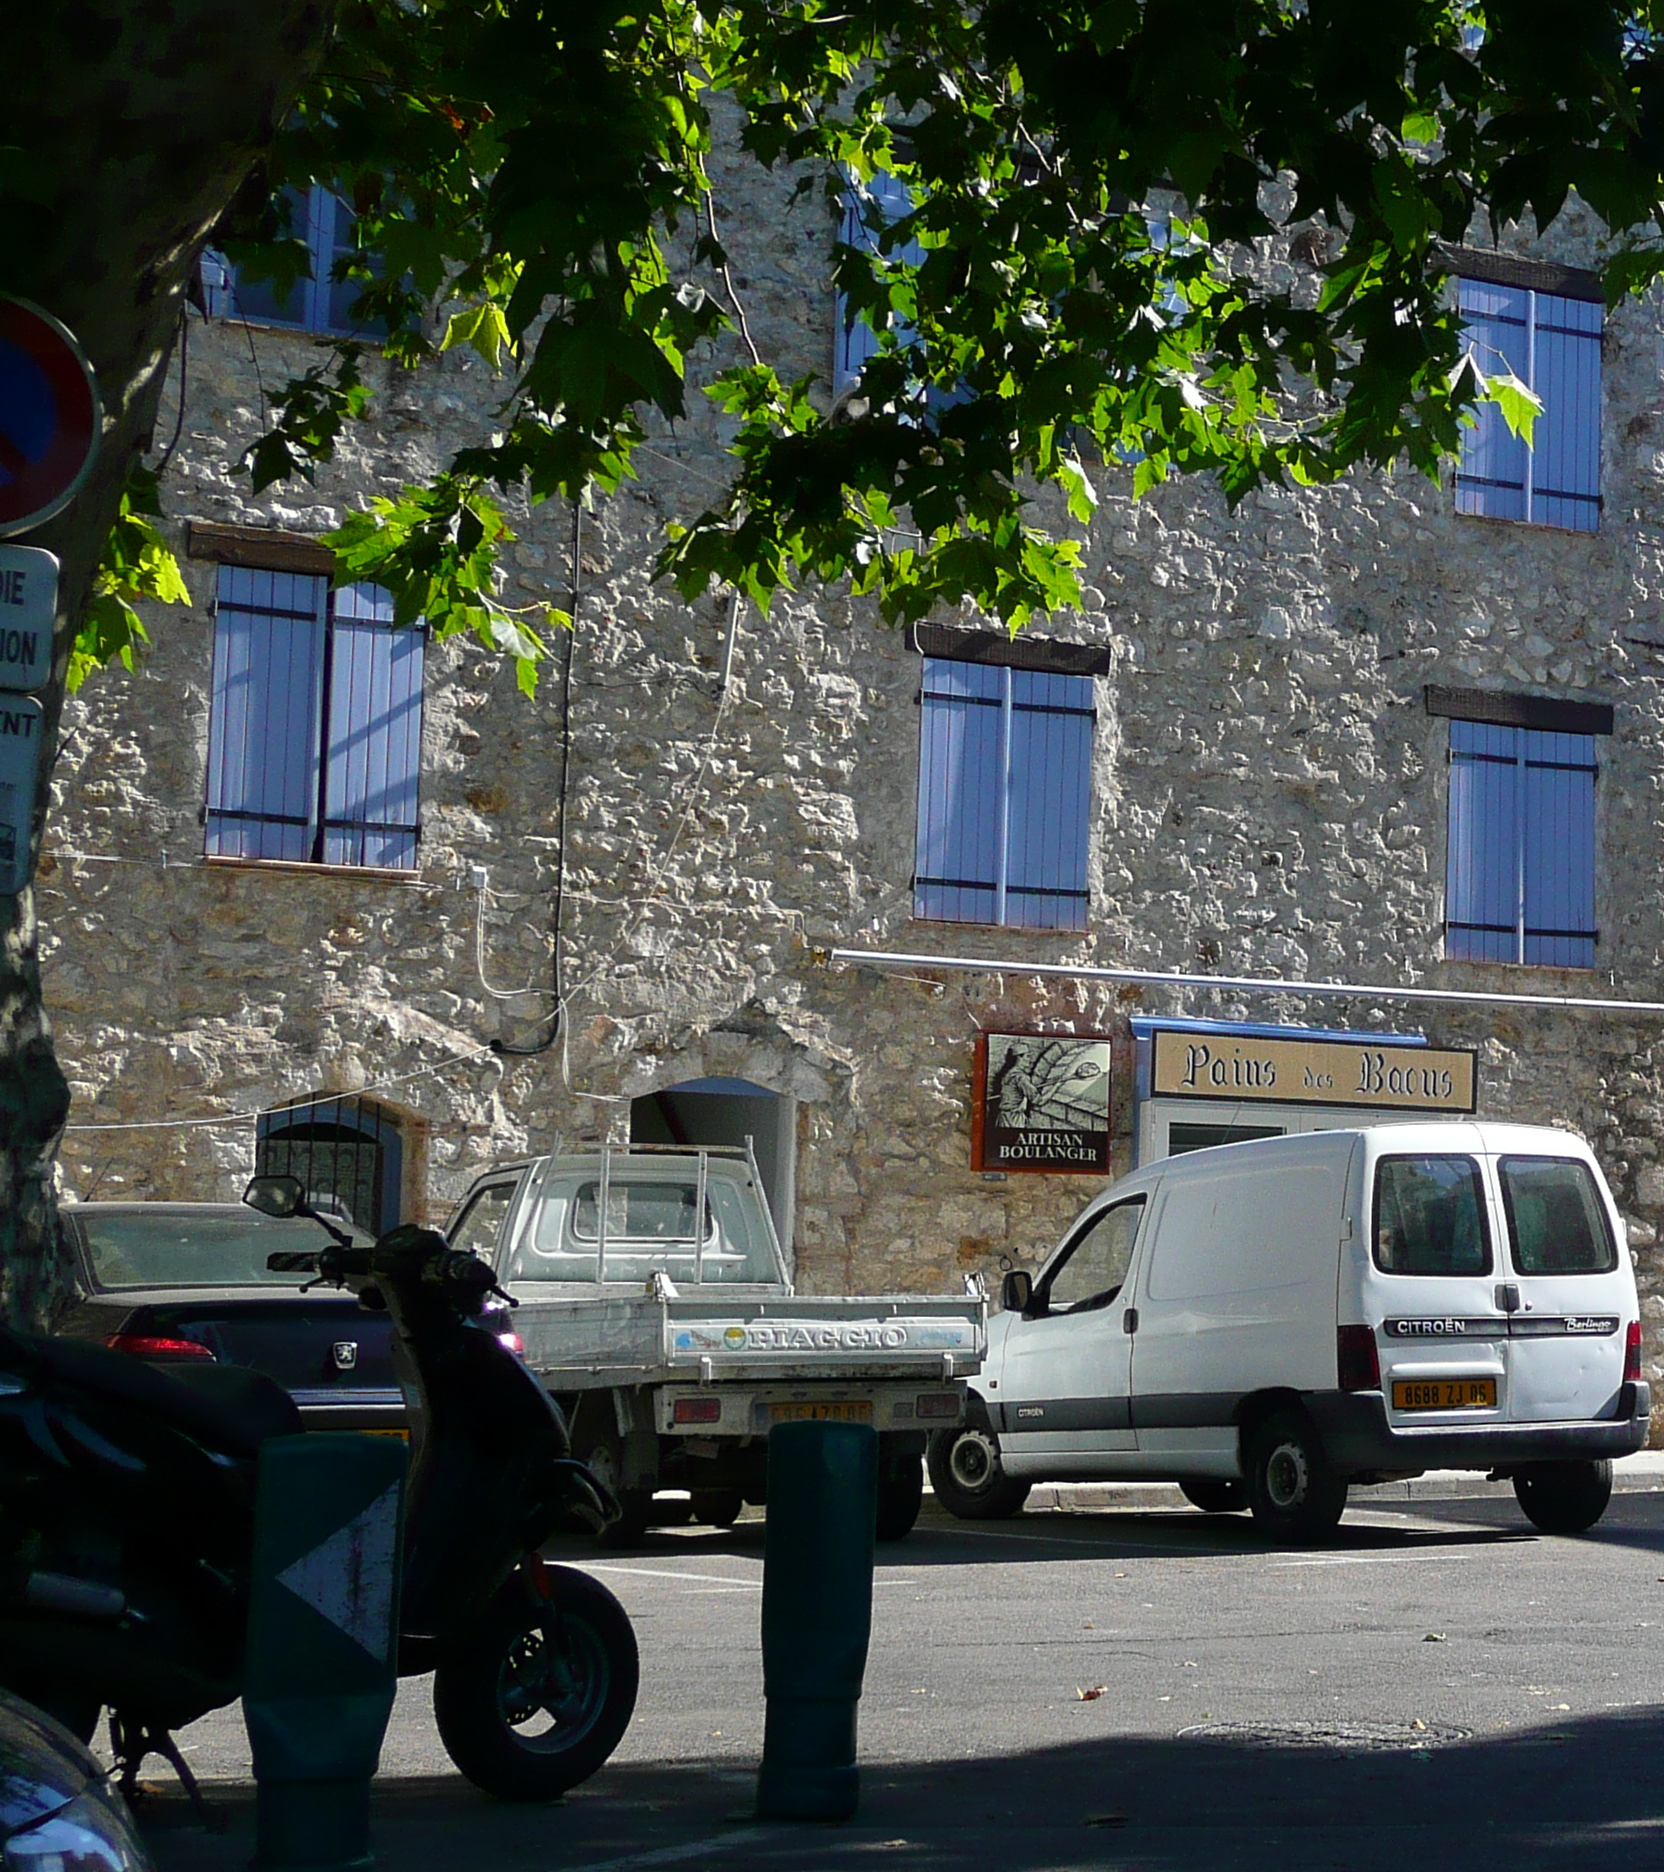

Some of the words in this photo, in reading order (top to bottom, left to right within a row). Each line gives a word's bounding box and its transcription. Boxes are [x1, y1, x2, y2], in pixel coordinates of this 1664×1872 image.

[1181, 1044, 1276, 1087] Pains
[1304, 1066, 1333, 1089] des
[1355, 1052, 1453, 1098] Baous
[1016, 1132, 1083, 1147] ARTISAN
[999, 1145, 1097, 1162] BOULANGER
[1397, 1317, 1465, 1334] CITROËN
[1563, 1316, 1612, 1333] Berlingo
[749, 1326, 907, 1350] PIAGGIO
[1405, 1385, 1439, 1405] 8688
[1447, 1385, 1464, 1404] ZJ
[1470, 1385, 1487, 1404] 06
